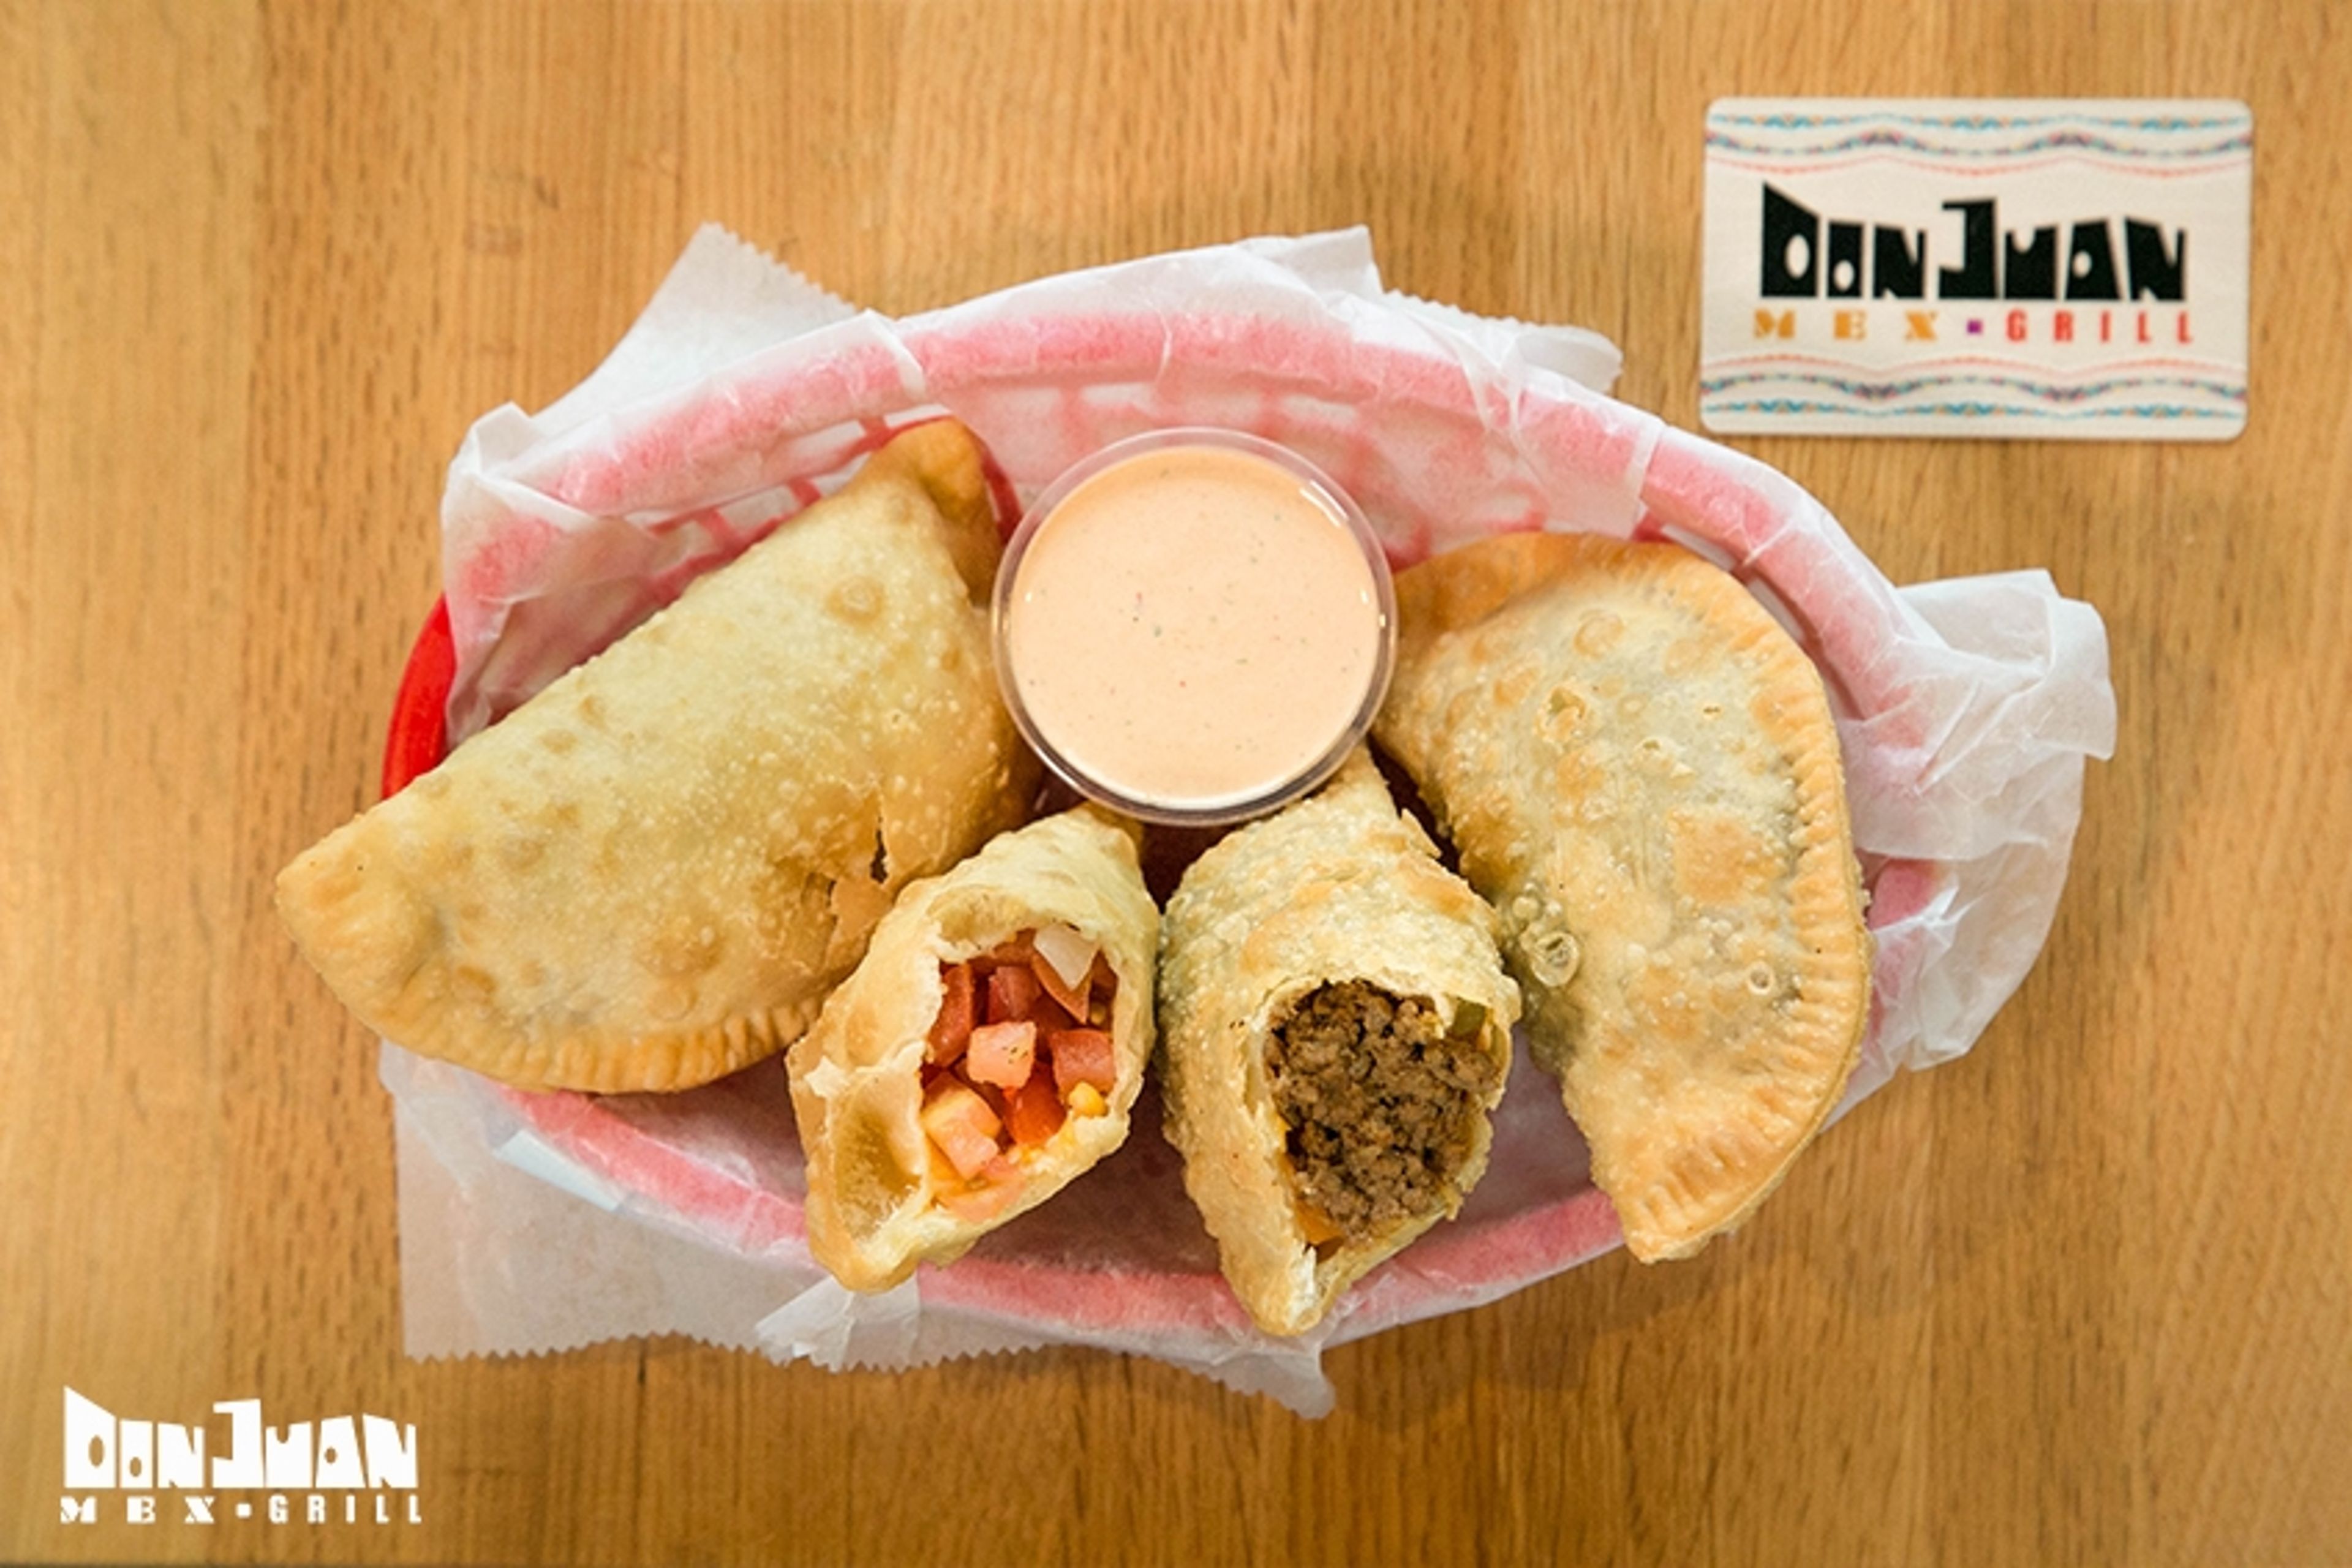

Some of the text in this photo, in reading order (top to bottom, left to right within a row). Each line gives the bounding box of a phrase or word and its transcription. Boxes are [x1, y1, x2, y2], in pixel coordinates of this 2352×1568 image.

[1761, 181, 2186, 301] DON JUAN
[1753, 309, 2193, 345] MEX GRILL
